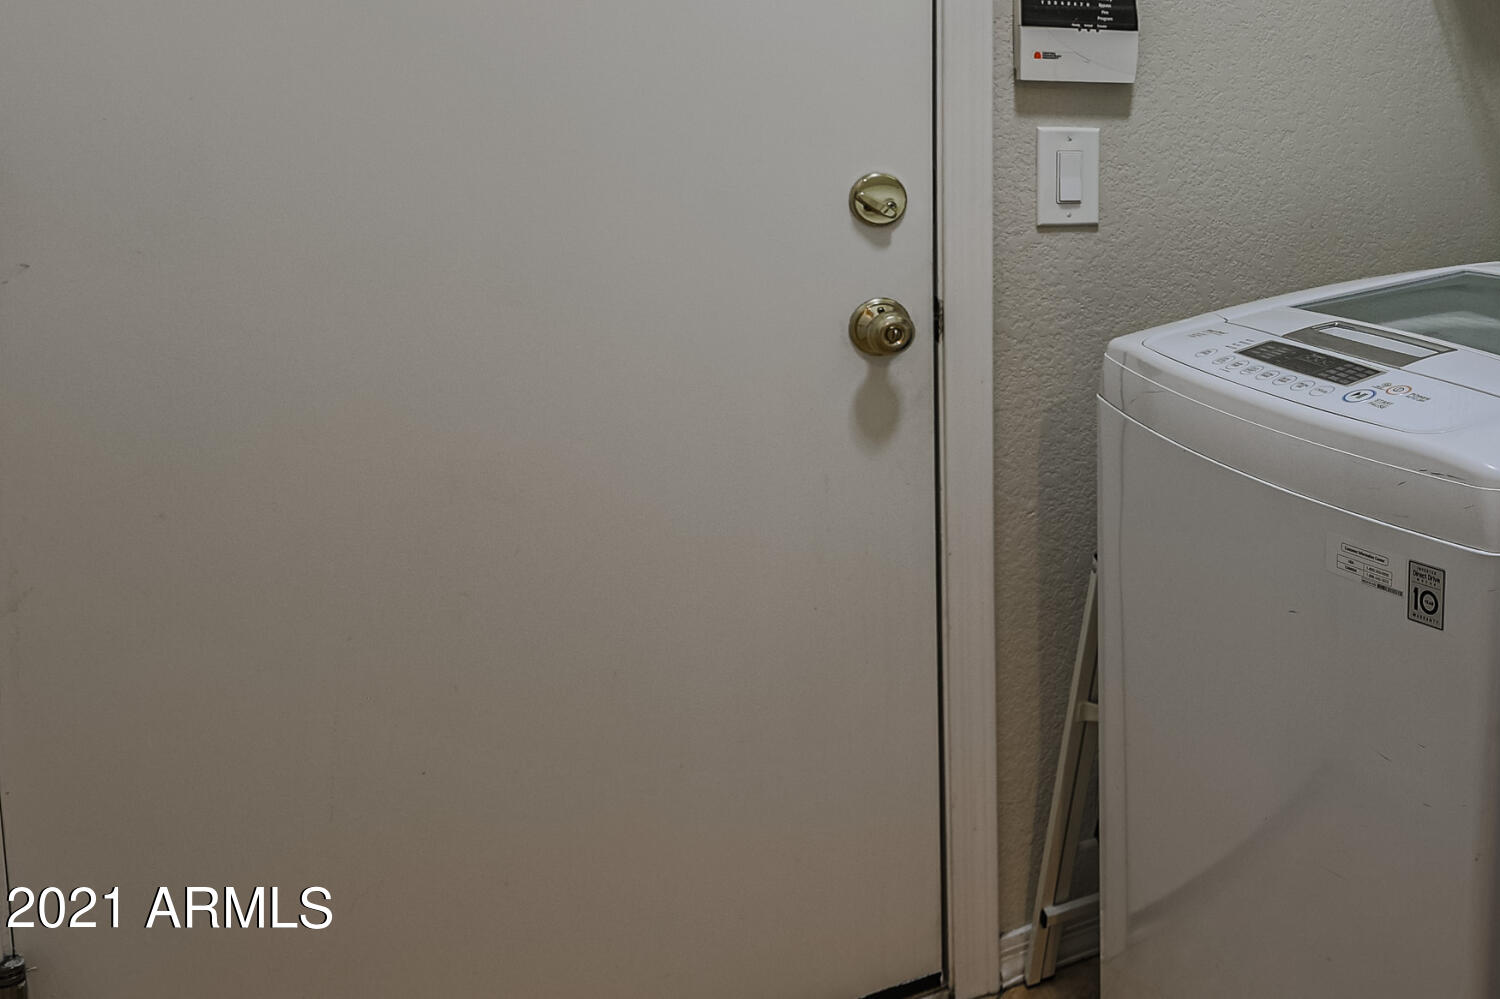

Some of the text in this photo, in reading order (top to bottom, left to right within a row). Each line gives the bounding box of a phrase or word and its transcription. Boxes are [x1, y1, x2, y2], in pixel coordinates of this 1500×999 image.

[1413, 570, 1440, 583] Direct Drive
[1414, 587, 1438, 616] 10
